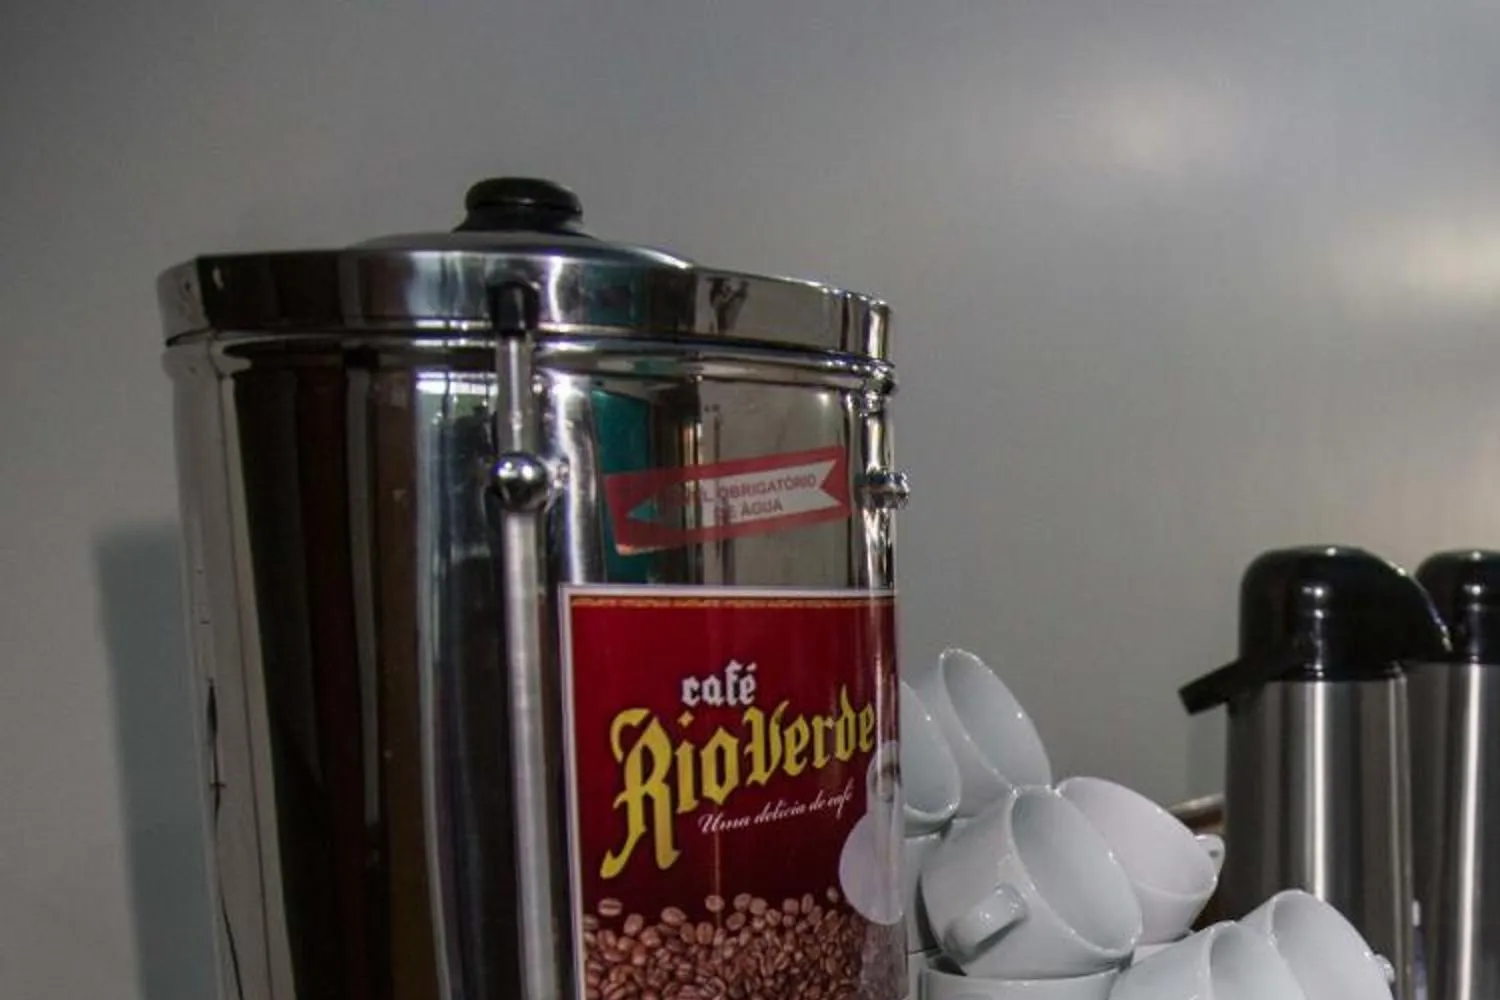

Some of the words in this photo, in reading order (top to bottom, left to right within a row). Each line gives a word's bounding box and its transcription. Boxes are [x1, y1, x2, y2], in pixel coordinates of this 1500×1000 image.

[717, 473, 817, 499] OBRIGATÓRIO
[740, 498, 784, 516] ÁGUA
[681, 660, 757, 706] café
[698, 812, 750, 834] Uma
